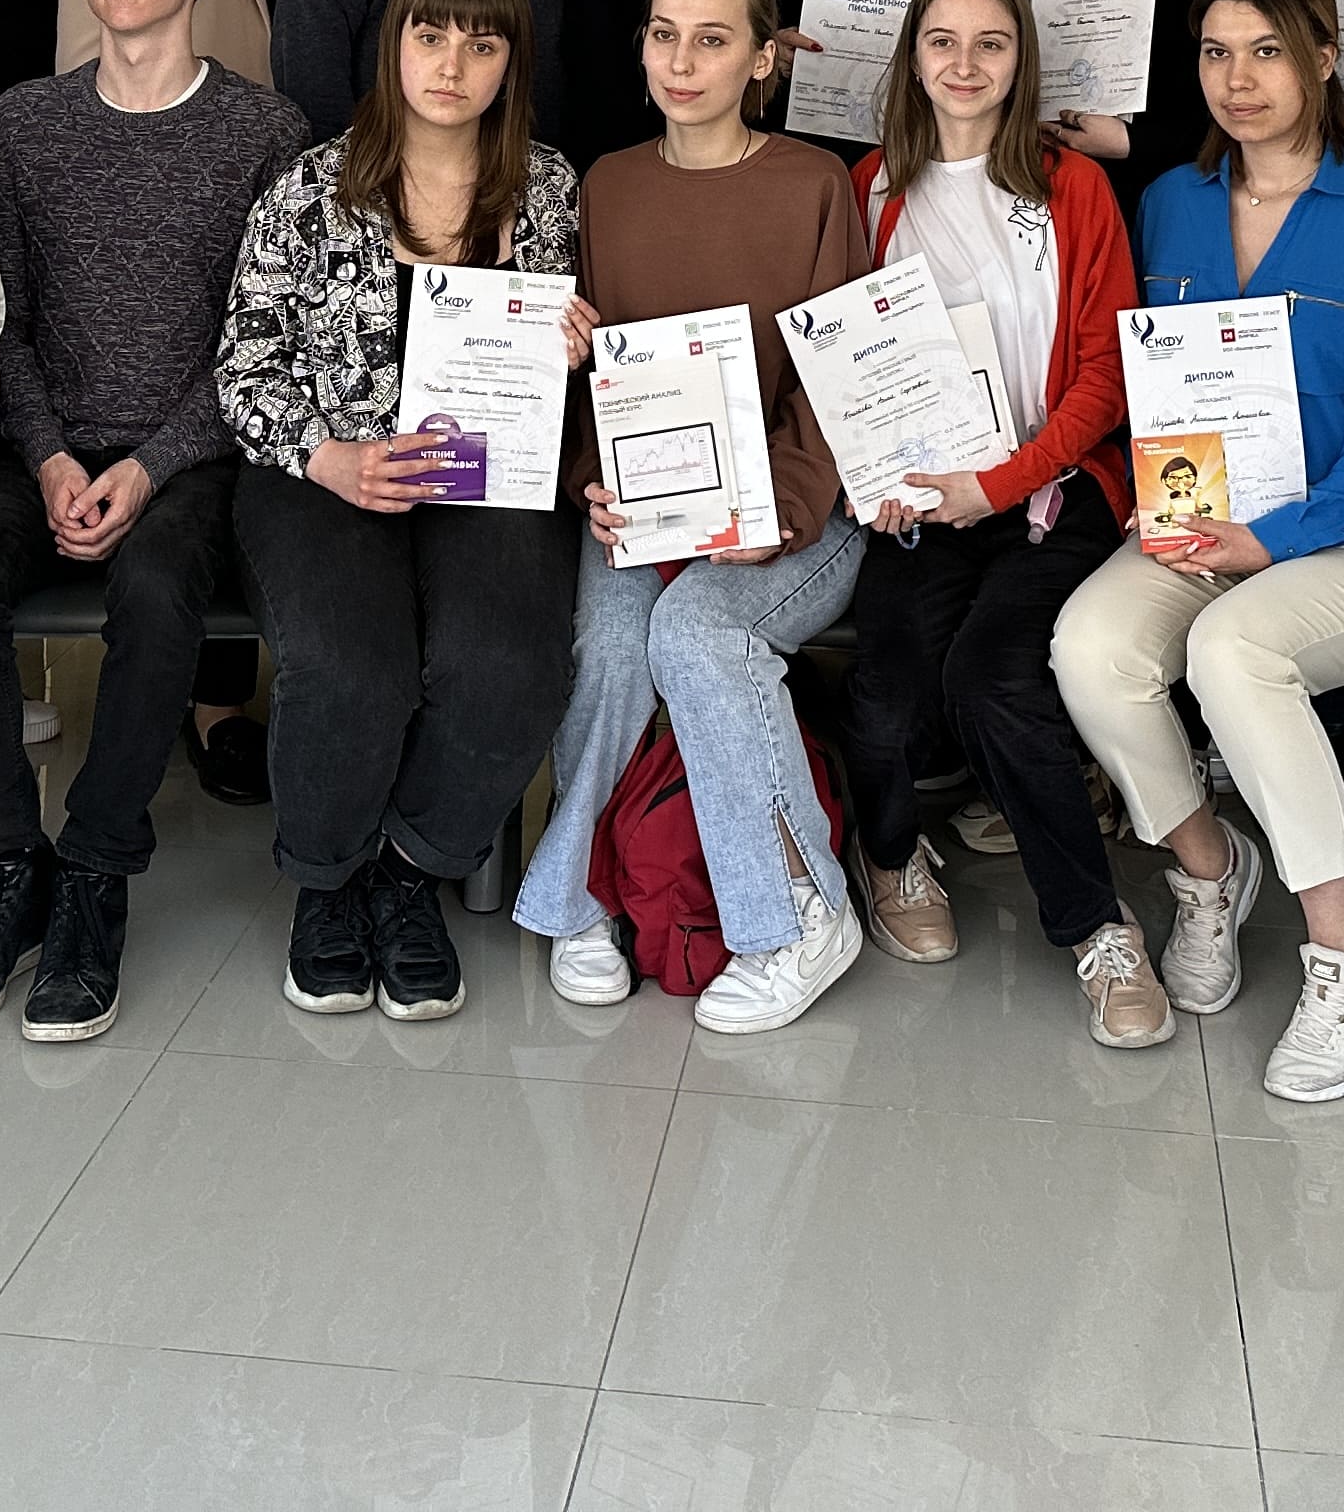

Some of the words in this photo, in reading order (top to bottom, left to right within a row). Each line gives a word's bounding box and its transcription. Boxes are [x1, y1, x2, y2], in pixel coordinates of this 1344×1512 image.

[847, 4, 885, 15] ПИСЬМО
[434, 296, 473, 308] СКФУ
[809, 318, 843, 341] СКФУ
[463, 337, 512, 349] ДИПЛОМ
[1145, 335, 1184, 349] СКФУ
[853, 337, 898, 363] ДИПЛОМ
[619, 351, 655, 366] СКФУ
[1184, 370, 1235, 384] ДИПЛОМ
[420, 450, 456, 459] ЧТЕНИЕ
